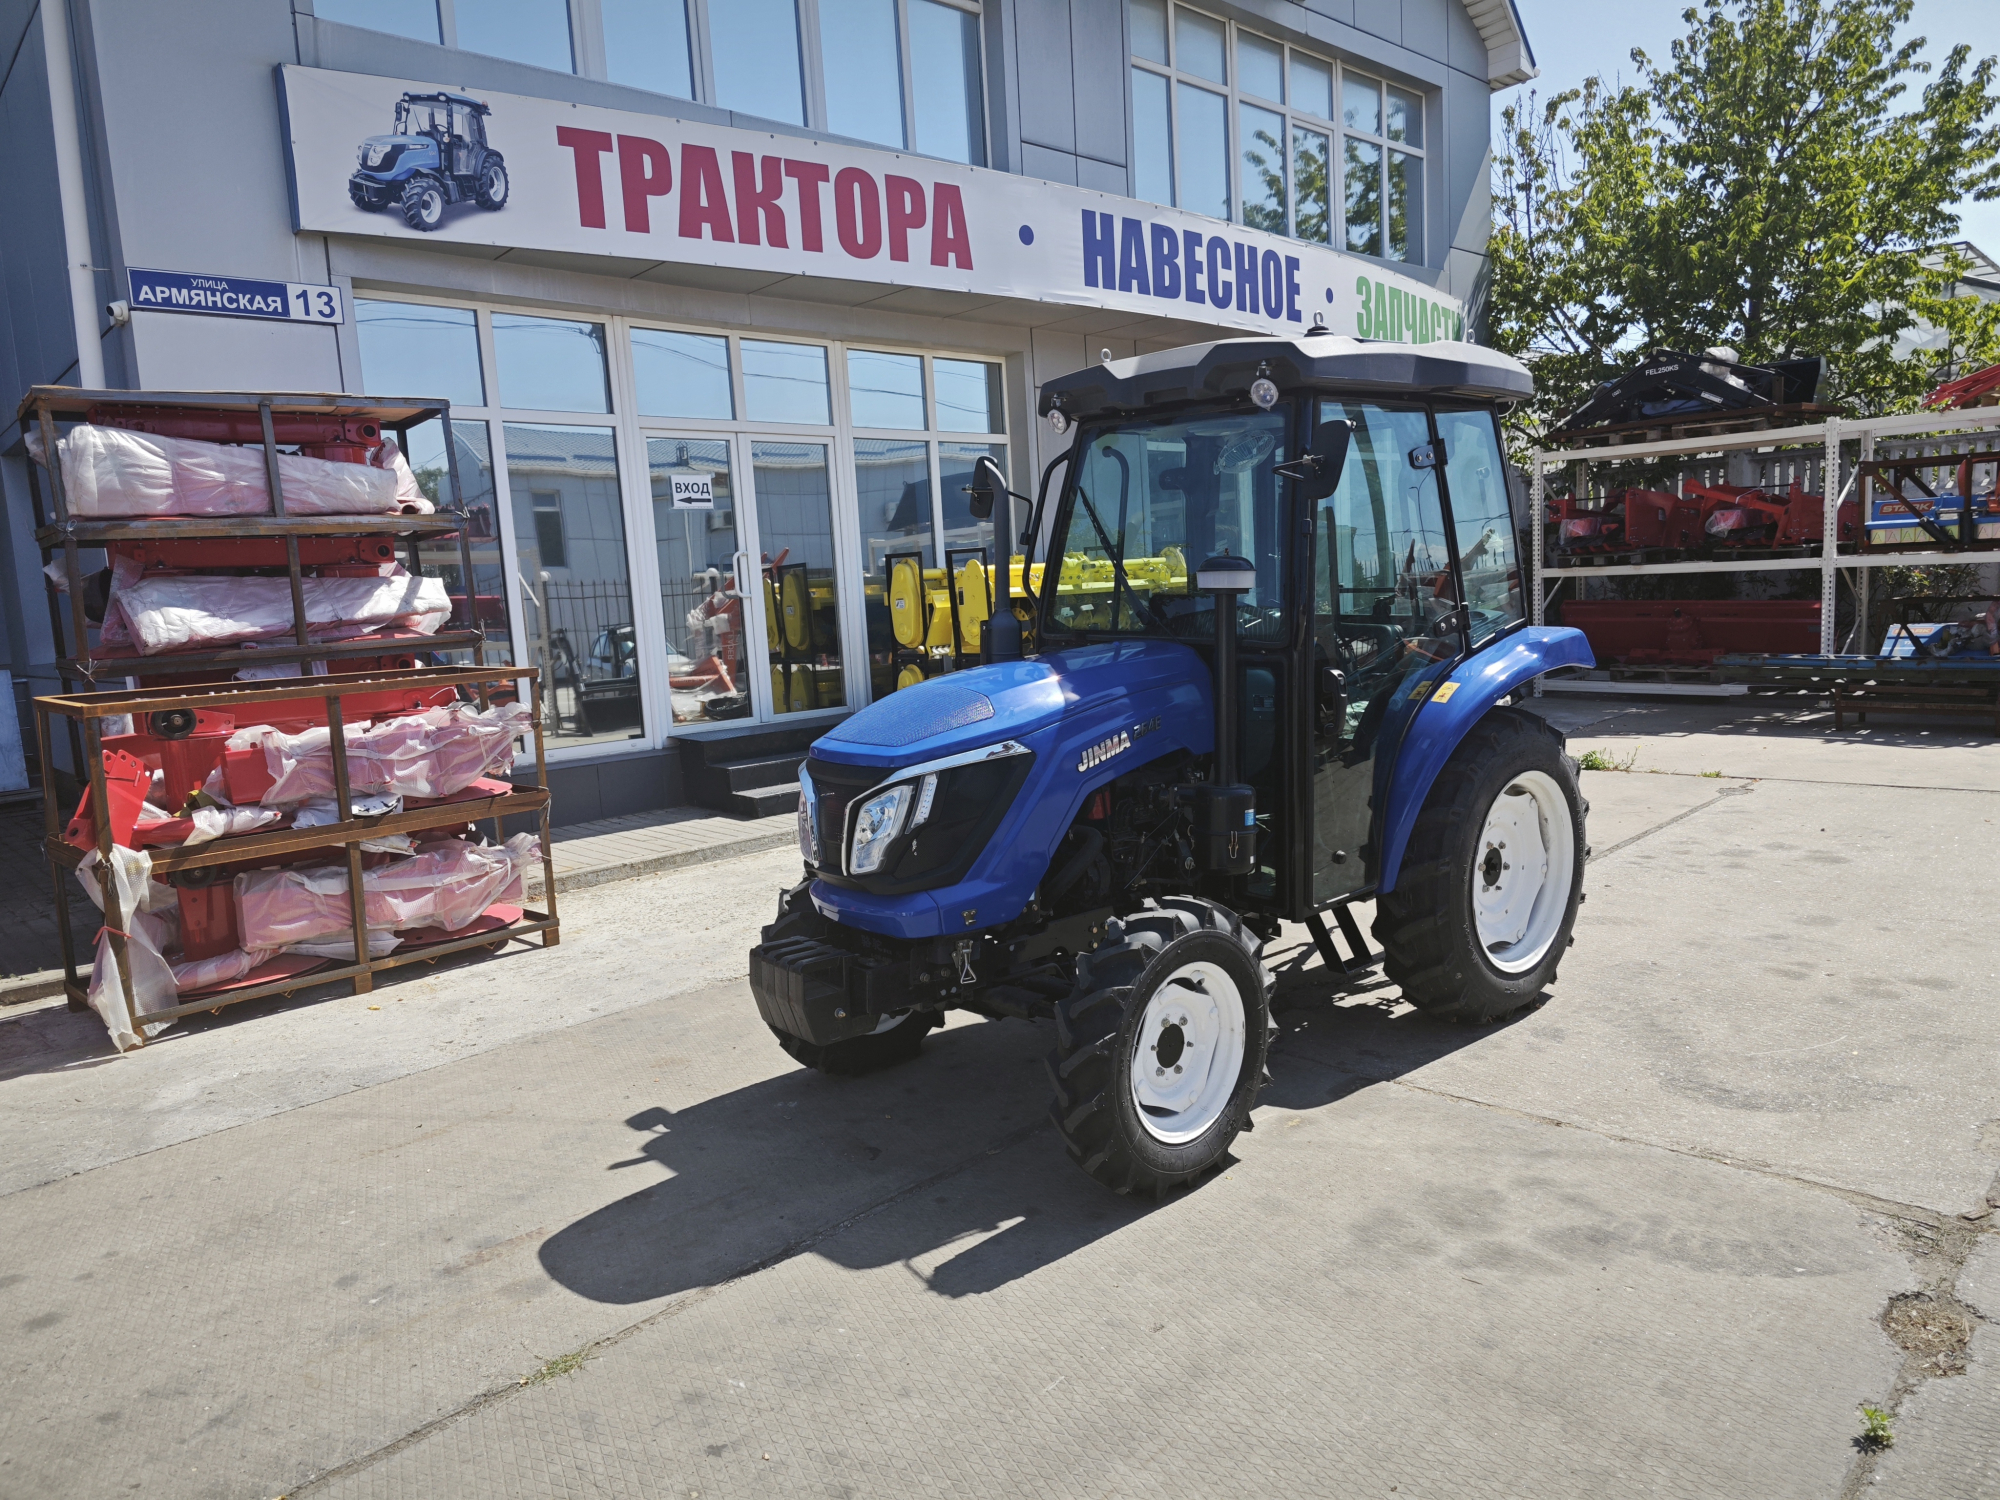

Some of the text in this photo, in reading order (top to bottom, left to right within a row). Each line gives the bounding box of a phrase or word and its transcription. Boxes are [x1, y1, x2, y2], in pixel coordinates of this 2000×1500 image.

[556, 125, 974, 271] ТРАКТОРА
[1081, 208, 1302, 323] НАВЕСНОЕ
[190, 278, 229, 291] УЛИЦА
[138, 285, 336, 319] АРМЯНСКАЯ 13
[1645, 364, 1679, 376] FEL250KS
[675, 482, 711, 497] ВХОД
[1077, 730, 1131, 773] JINMA
